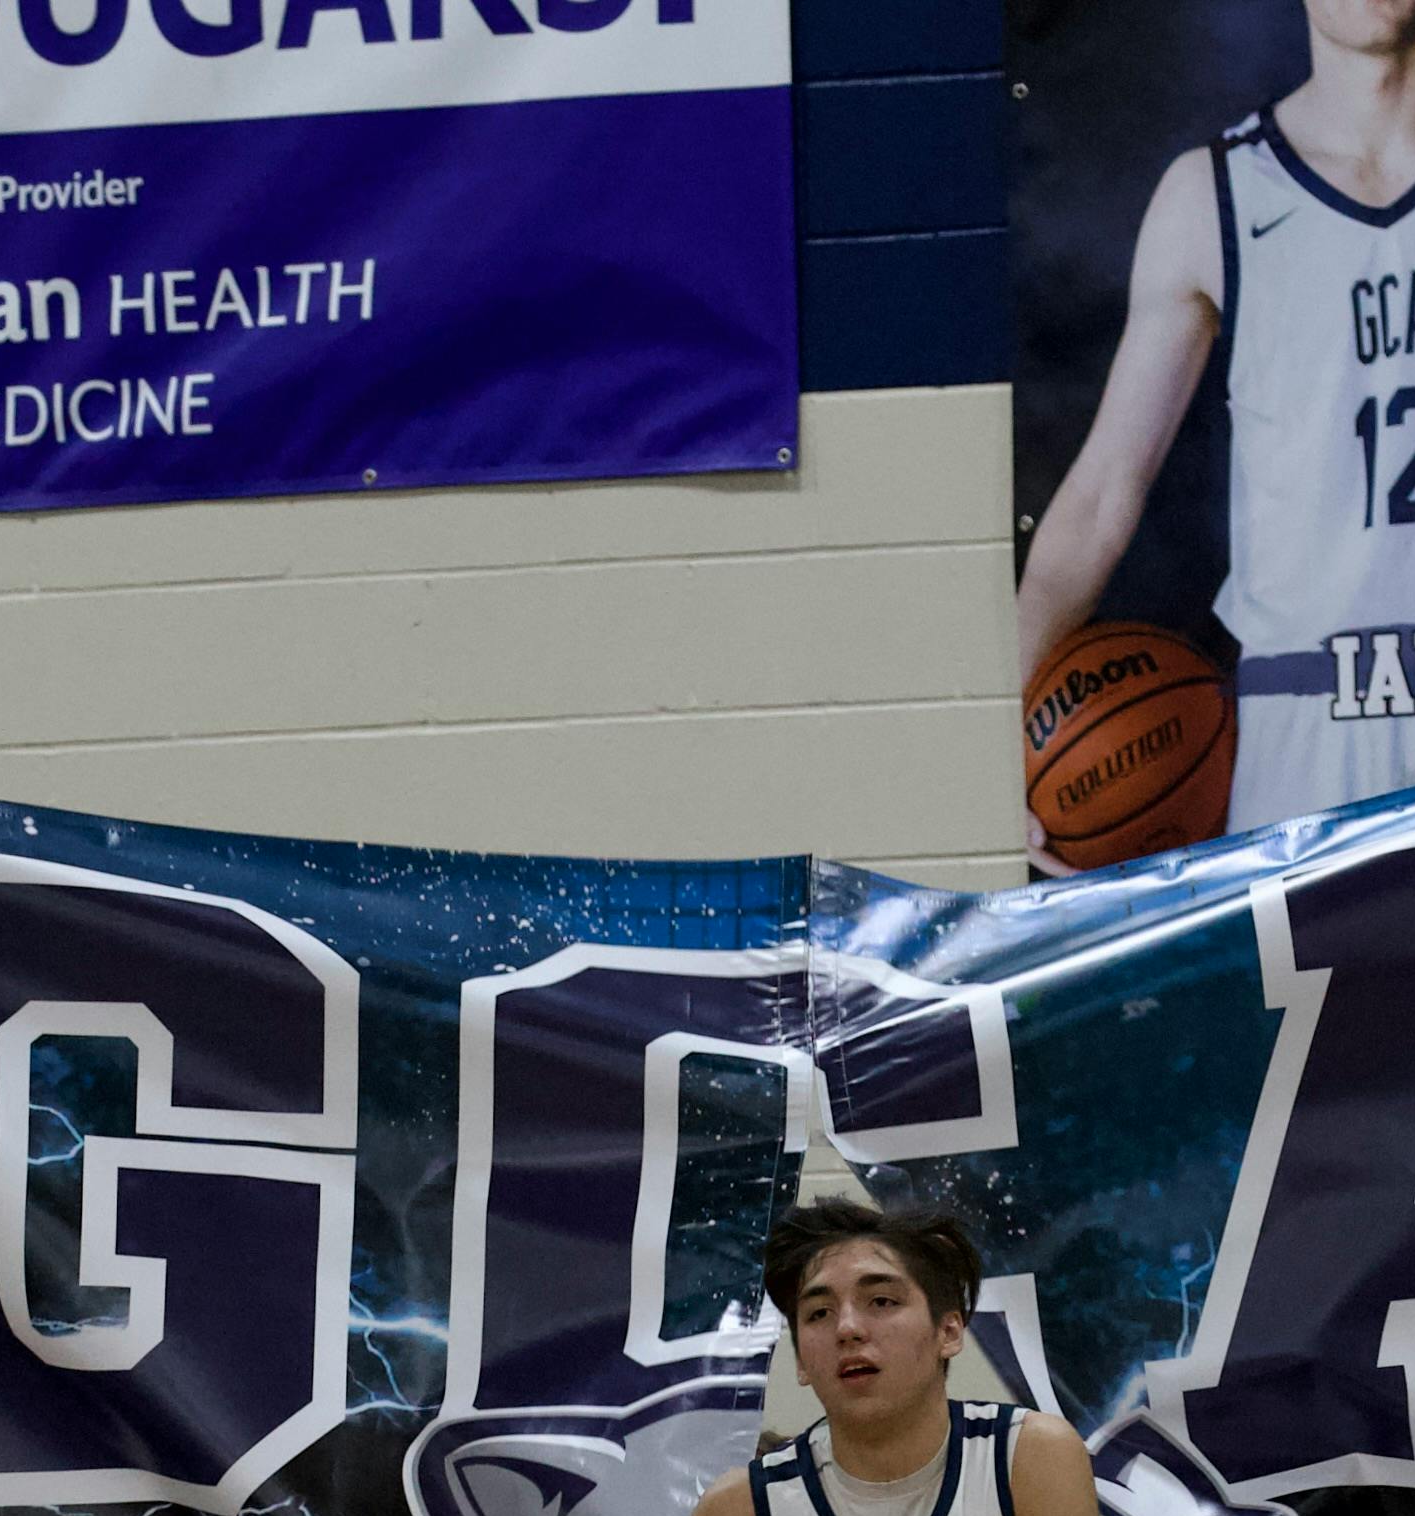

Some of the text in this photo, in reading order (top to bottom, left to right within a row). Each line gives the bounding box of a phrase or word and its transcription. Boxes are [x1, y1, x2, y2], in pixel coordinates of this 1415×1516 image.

[109, 258, 376, 336] HEALTH
[1025, 650, 1160, 751] Wilson
[1054, 715, 1184, 815] EVOLUTION
